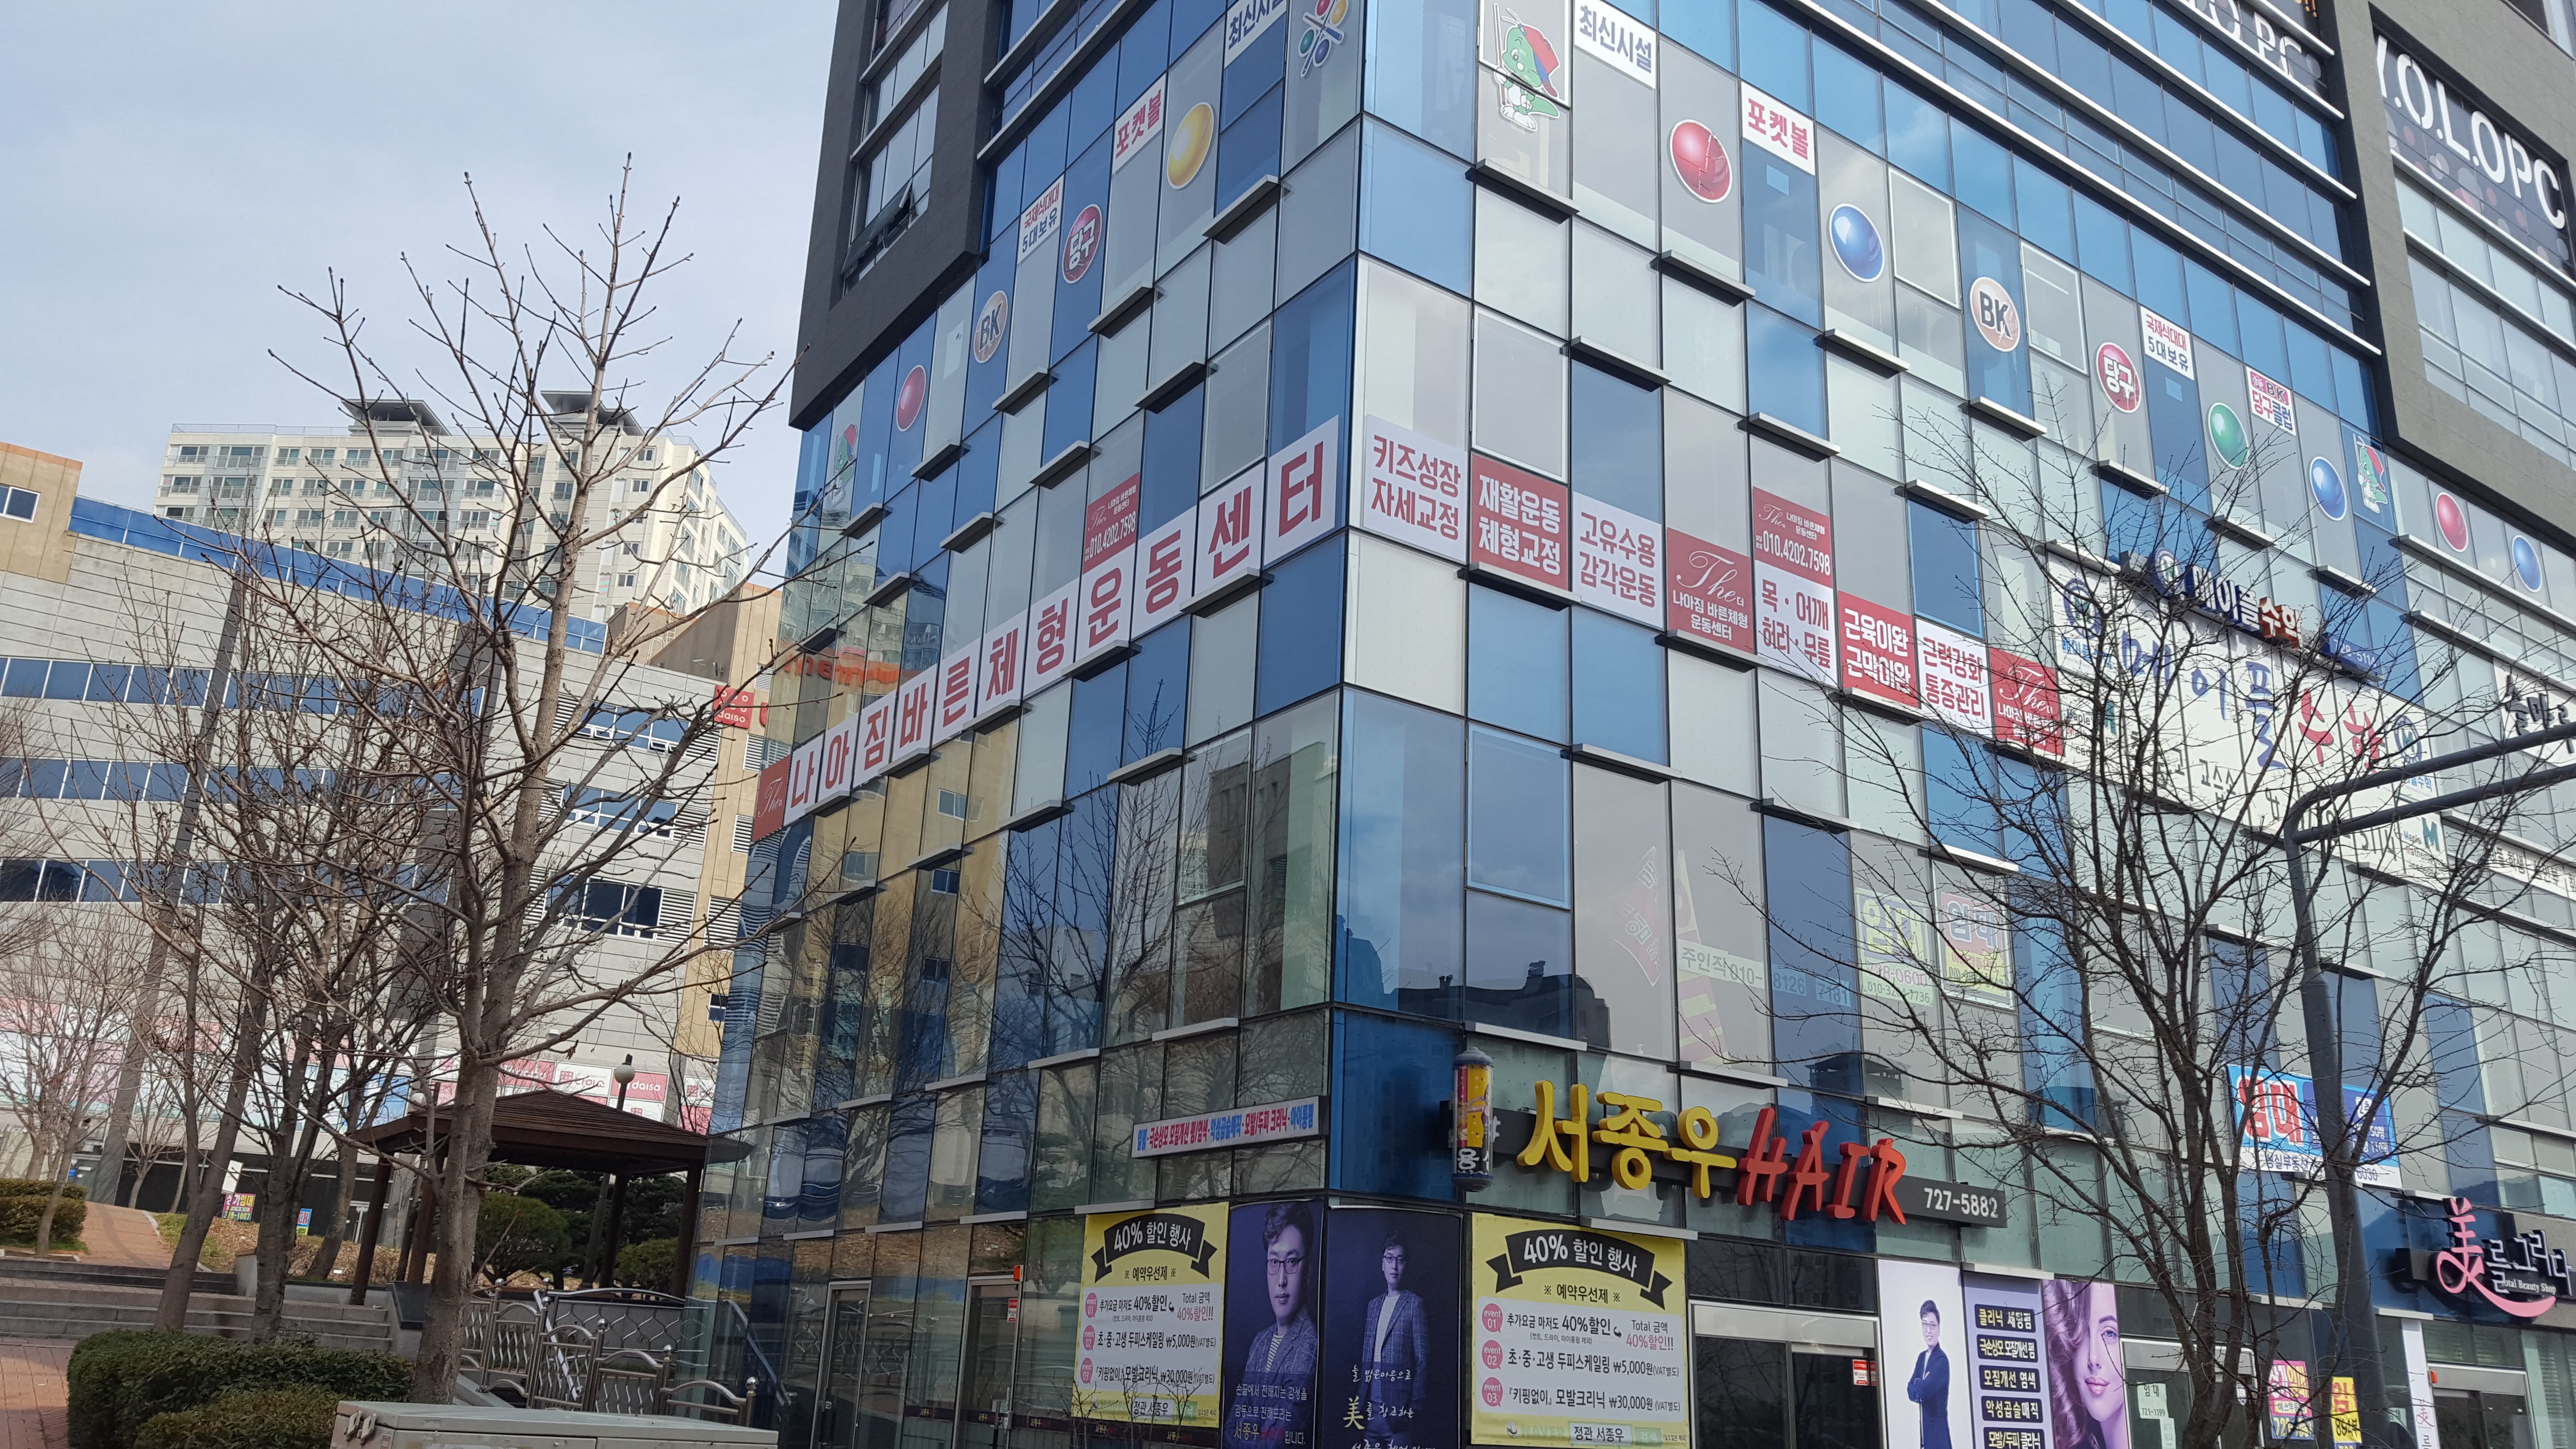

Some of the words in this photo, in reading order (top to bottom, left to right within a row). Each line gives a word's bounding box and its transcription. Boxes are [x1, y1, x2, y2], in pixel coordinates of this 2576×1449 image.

[1229, 0, 1283, 50] 최신시
[1579, 4, 1652, 73] 최신시설
[1115, 89, 1162, 160] 포켓볼
[1748, 98, 1808, 160] 포켓볼
[1025, 182, 1060, 229] 국제식대대
[1069, 218, 1095, 270] 당구
[978, 301, 1002, 353] BK
[1979, 290, 2012, 338] BK
[2146, 314, 2187, 351] 국제식대대
[2104, 355, 2133, 396] 당구
[2266, 380, 2286, 402] BK
[1373, 434, 1461, 498] 키즈성장
[1370, 477, 1459, 541] 자세교정
[1479, 474, 1561, 534] 재활운동
[1089, 511, 1136, 559] 010.4202.7598
[1786, 512, 1803, 525] 나아짐
[1803, 516, 1825, 535] 바른체형
[1796, 526, 1817, 540] 운동센터
[1478, 516, 1561, 576] 체형교정
[1580, 511, 1656, 568] 고유수용
[1763, 531, 1831, 576] 010.4202.7598
[1579, 551, 1656, 608] 감각운동
[1676, 550, 1738, 603] The
[1673, 590, 1705, 613] 나아짐
[1707, 599, 1749, 629] 바른체형
[1762, 579, 1778, 612] 목
[1796, 592, 1829, 631] 어깨
[2192, 565, 2302, 649] 메이플수학
[1690, 613, 1732, 641] 운동센터
[1844, 608, 1908, 657] 근육이완
[1762, 617, 1790, 654] 허리
[1804, 631, 1831, 669] 무릎
[1846, 645, 1911, 695] 근막이완
[1923, 636, 1982, 684] 근력강화
[1925, 673, 1985, 720] 통증관리
[717, 709, 746, 723] daiso
[1863, 899, 1924, 961] 임대
[1948, 901, 1998, 949] 임대
[632, 1080, 661, 1092] daiso
[2238, 1076, 2304, 1145] 임대
[1517, 1080, 1737, 1199] 서종우
[1737, 1108, 1906, 1224] HAIR
[1924, 1188, 1998, 1218] 727-5882
[1114, 1221, 1143, 1252] 40%
[1146, 1222, 1167, 1245] 할인
[1169, 1223, 1191, 1252] 행사
[1523, 1234, 1568, 1264] 40%
[1573, 1238, 1603, 1266] 할인
[1607, 1247, 1637, 1278] 행사
[1132, 1266, 1168, 1282] 예약우선제
[2518, 1281, 2540, 1293] Beauty
[2541, 1283, 2556, 1294] Shop
[1100, 1299, 1117, 1312] 추가요금
[1119, 1299, 1132, 1312] 마저도
[1182, 1292, 1197, 1304] Total
[1198, 1291, 1210, 1304] 금액
[1557, 1284, 1608, 1304] 예약우선제
[1484, 1308, 1501, 1318] event
[1487, 1318, 1497, 1329] 01
[1507, 1313, 1536, 1329] 추가요금
[1538, 1315, 1560, 1330] 마저도
[1562, 1315, 1610, 1336] 40%할인
[1631, 1319, 1651, 1332] Total
[1653, 1320, 1668, 1334] 금액
[1979, 1308, 2004, 1328] 클리닉
[1128, 1331, 1164, 1350] 두피스케일링
[1484, 1346, 1501, 1355] event
[1980, 1338, 2004, 1355] 극손상모
[1487, 1355, 1497, 1366] 02
[1557, 1352, 1610, 1374] 두피스케일링
[1236, 1384, 1260, 1397] 손끝에서
[1261, 1384, 1286, 1399] 전해지는
[1288, 1386, 1307, 1401] 감성을
[1484, 1382, 1501, 1392] event
[1983, 1369, 2017, 1387] 모질개선
[2019, 1371, 2037, 1389] 염색
[2144, 1383, 2160, 1398] 임대
[1133, 1401, 1147, 1416] 정관
[1148, 1401, 1169, 1417] 서종우
[1379, 1402, 1415, 1419] 창조하는
[1487, 1392, 1497, 1403] 03
[1556, 1388, 1605, 1409] 모발크리닉
[1986, 1400, 2039, 1419] 악성곱슬매직
[1235, 1404, 1259, 1418] 감동으로
[1260, 1405, 1292, 1421] 전해드리는
[2141, 1407, 2165, 1417] 721-1199
[1234, 1422, 1259, 1441] 서종우
[1574, 1426, 1593, 1441] 정관
[1597, 1427, 1625, 1442] 서종우
[1988, 1431, 2019, 1449] 모발/두피
[2020, 1433, 2041, 1449] 클리닉
